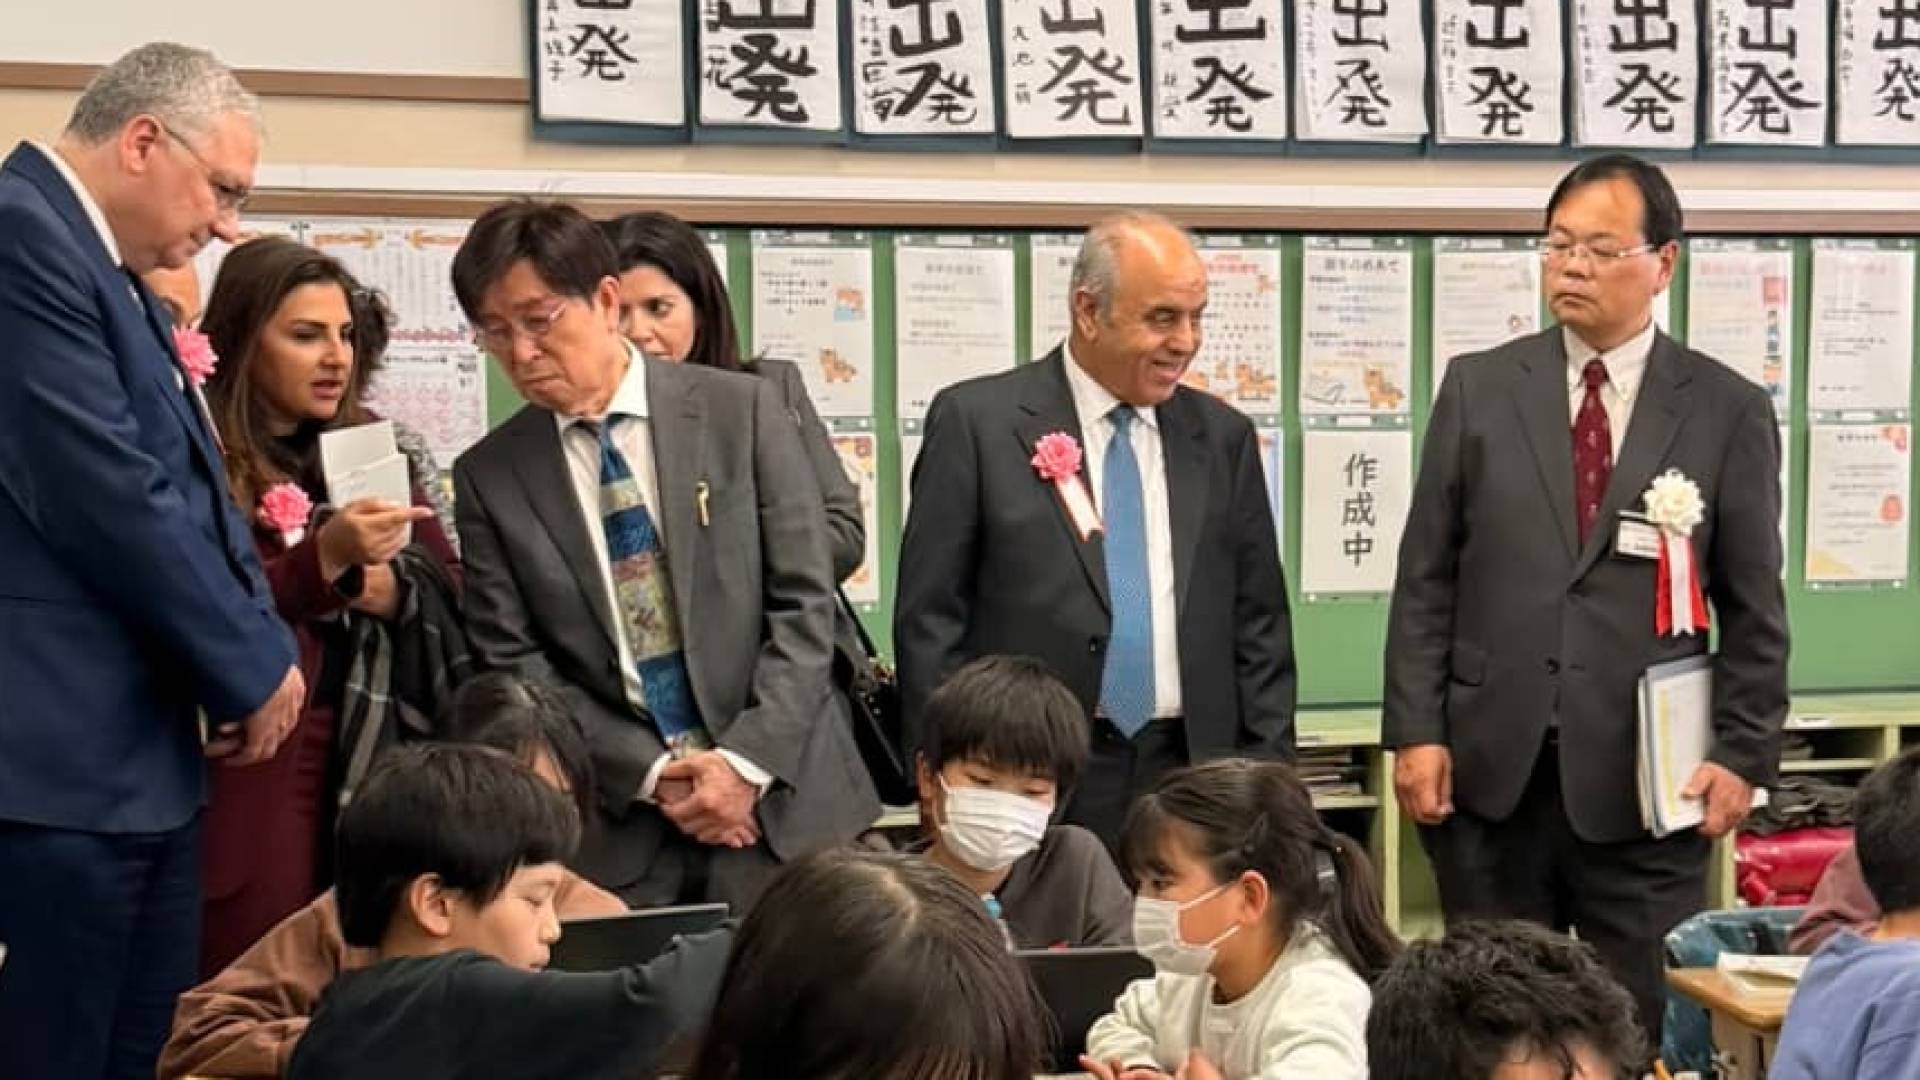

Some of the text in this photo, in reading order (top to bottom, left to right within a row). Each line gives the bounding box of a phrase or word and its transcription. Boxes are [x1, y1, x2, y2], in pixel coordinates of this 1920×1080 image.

[569, 0, 638, 81] 発
[1604, 0, 1684, 132] 出発
[1343, 454, 1377, 566] 作成中
